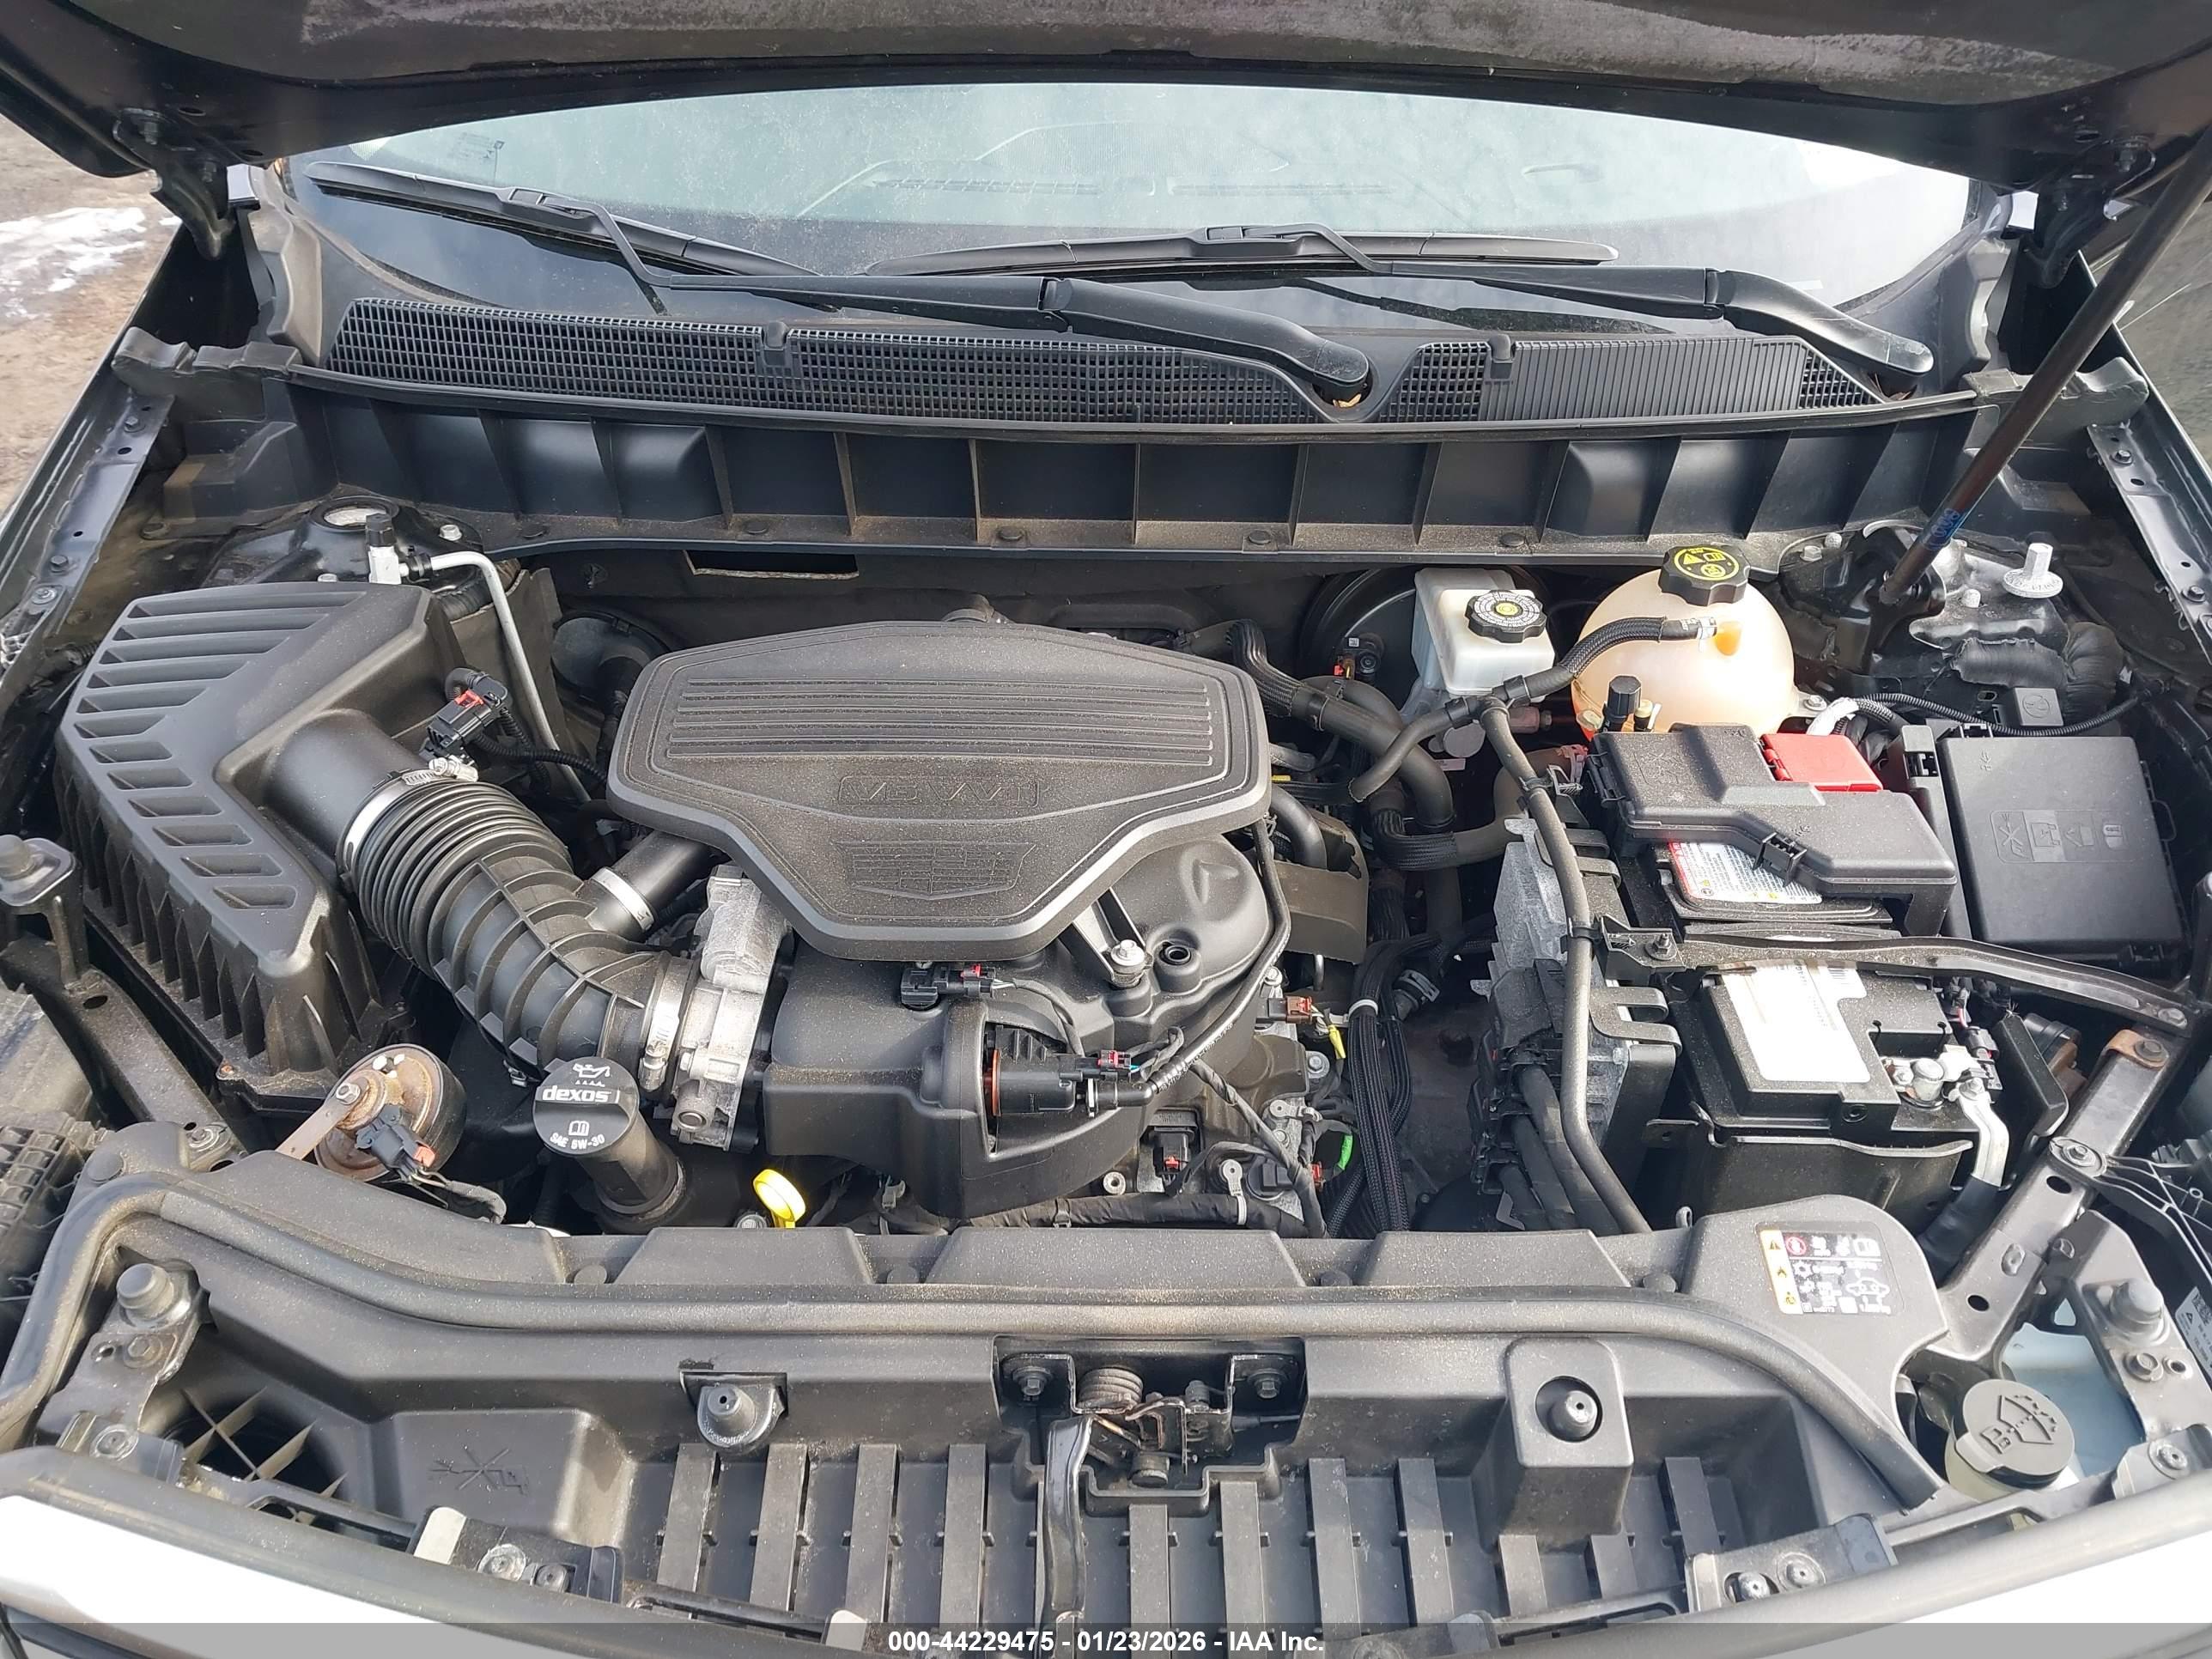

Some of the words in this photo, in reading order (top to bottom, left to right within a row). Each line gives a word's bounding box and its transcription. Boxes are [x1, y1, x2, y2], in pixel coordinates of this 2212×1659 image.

[542, 1085, 611, 1103] dexos
[550, 1132, 568, 1147] SAE
[571, 1133, 605, 1149] 5W-30
